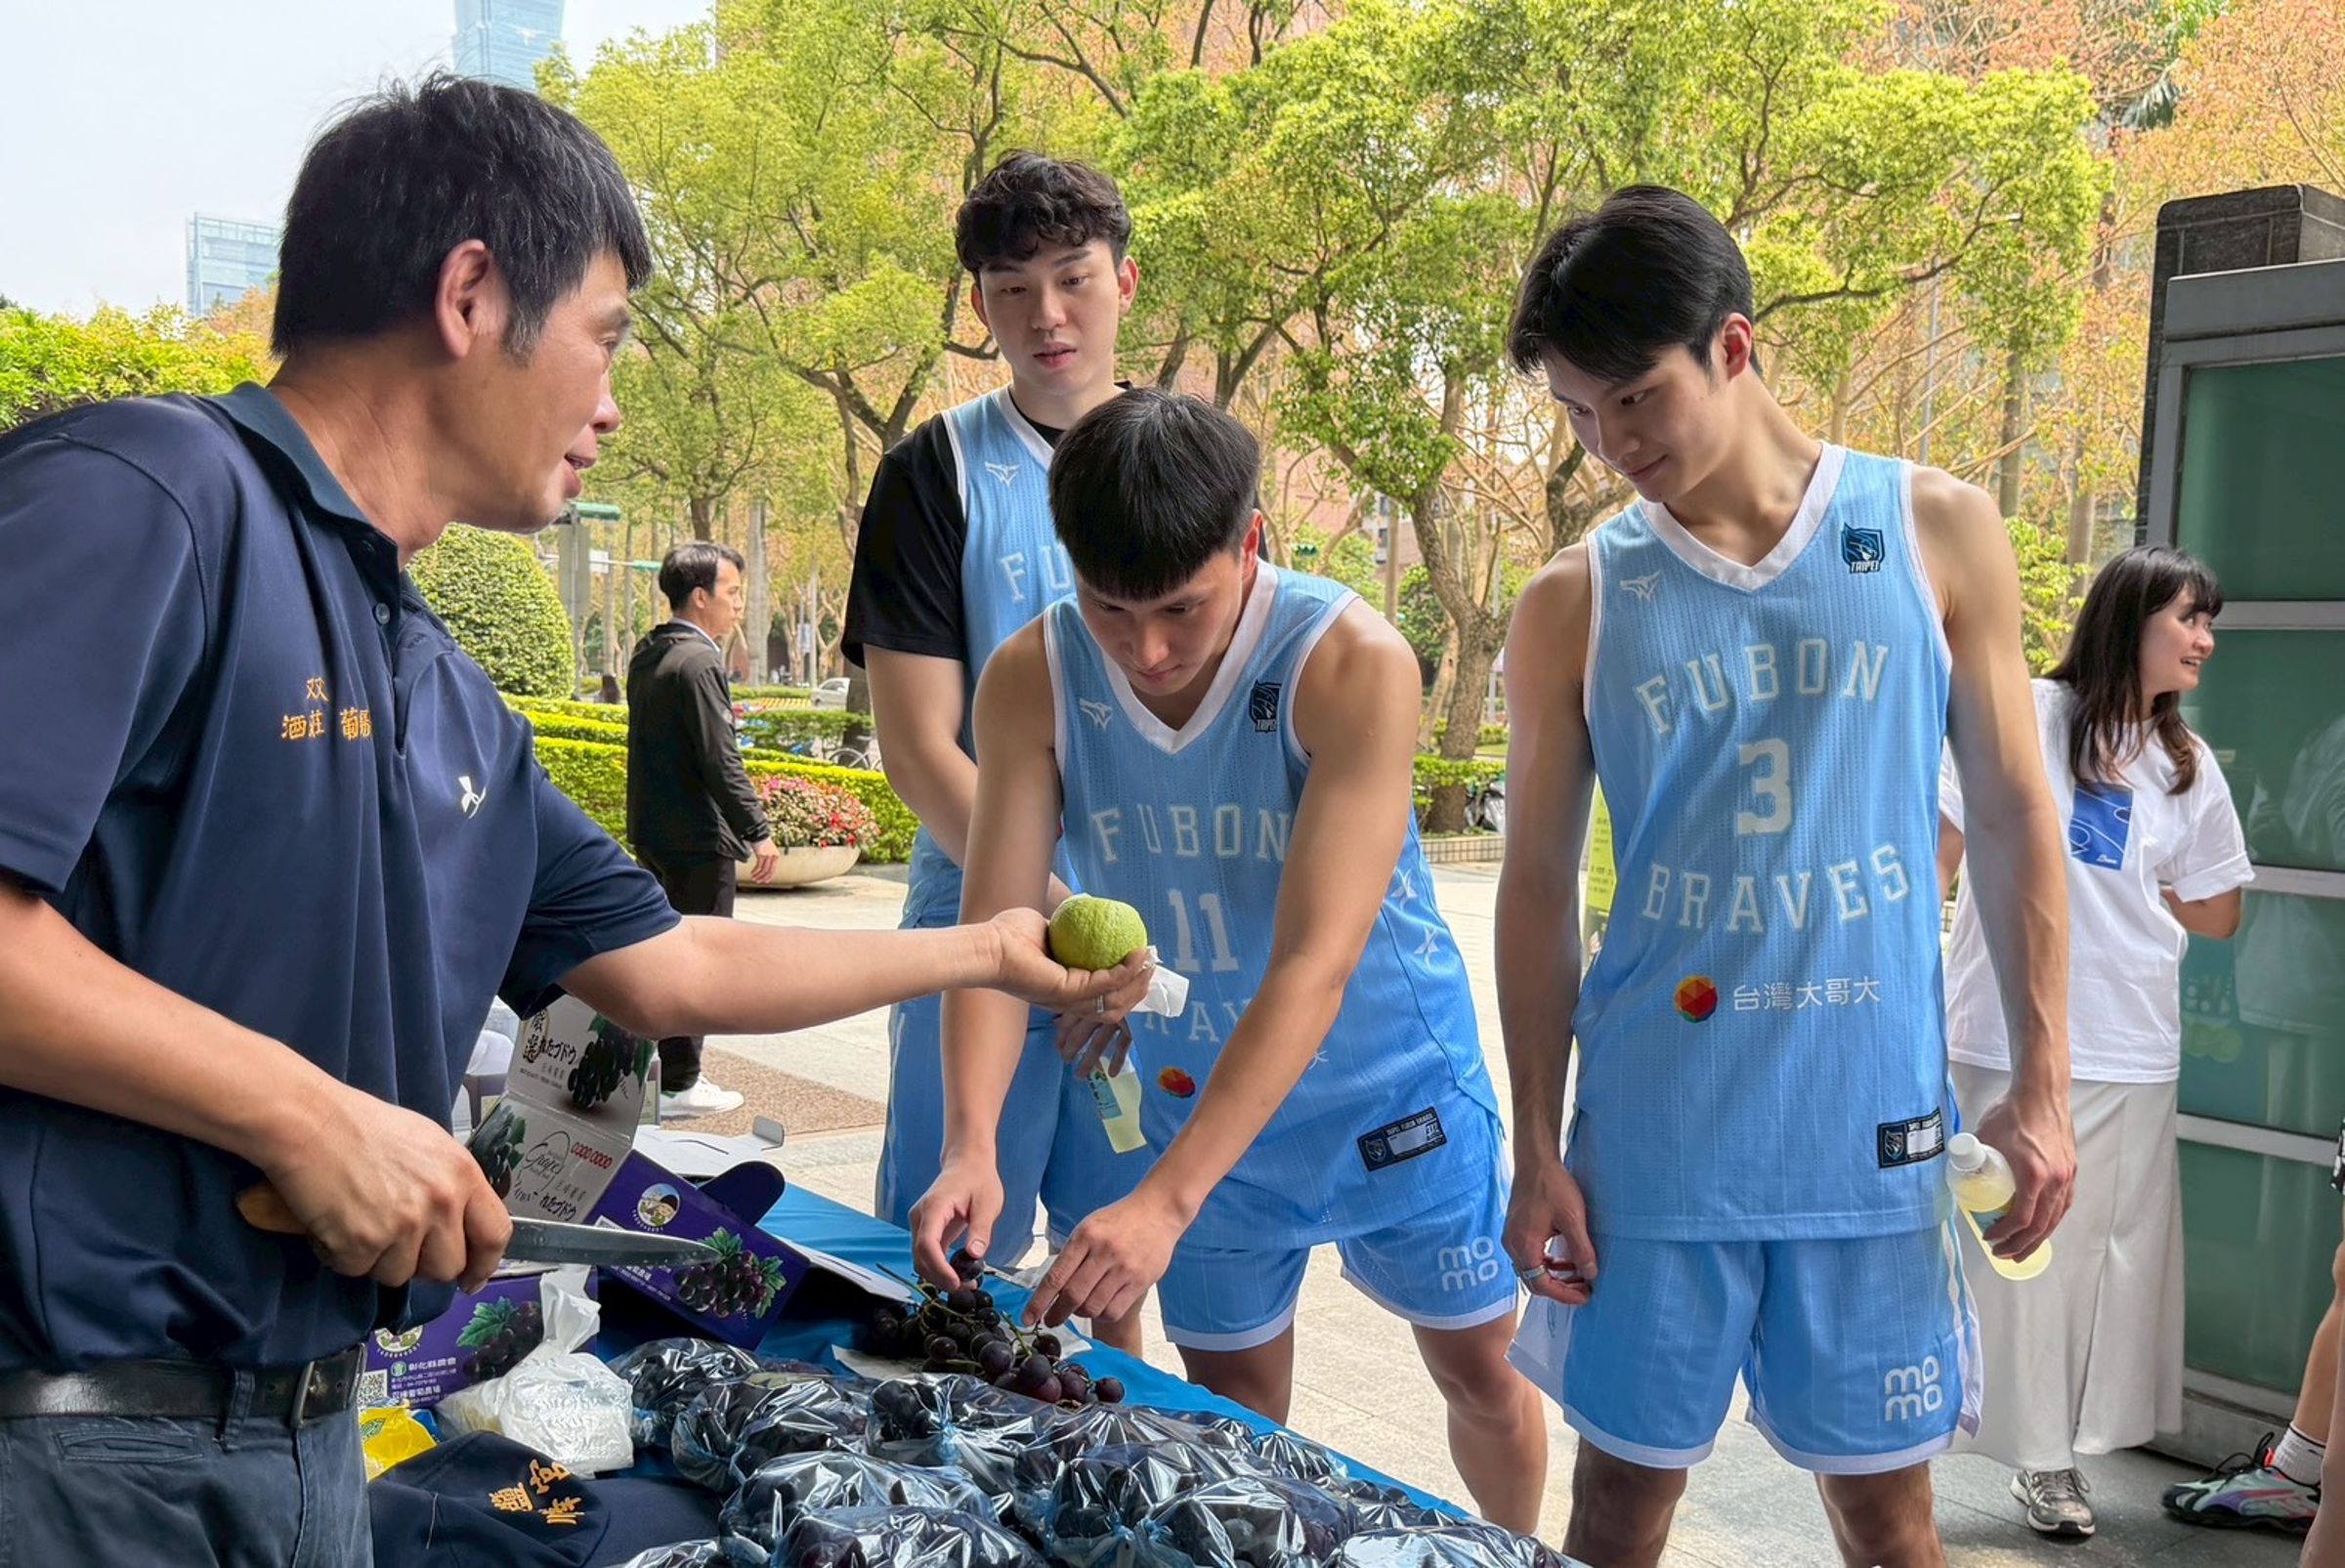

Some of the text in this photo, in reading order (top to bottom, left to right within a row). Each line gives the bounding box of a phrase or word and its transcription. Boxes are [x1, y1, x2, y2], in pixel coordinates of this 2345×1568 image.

[1000, 542, 1072, 602] FU
[1635, 637, 1890, 735] FUBON
[1736, 738, 1791, 835] 3
[1089, 803, 1292, 865] FUBON
[1168, 887, 1240, 973] 11
[1642, 842, 1912, 933] BRAVES
[1732, 975, 1881, 1012] 台灣大哥大
